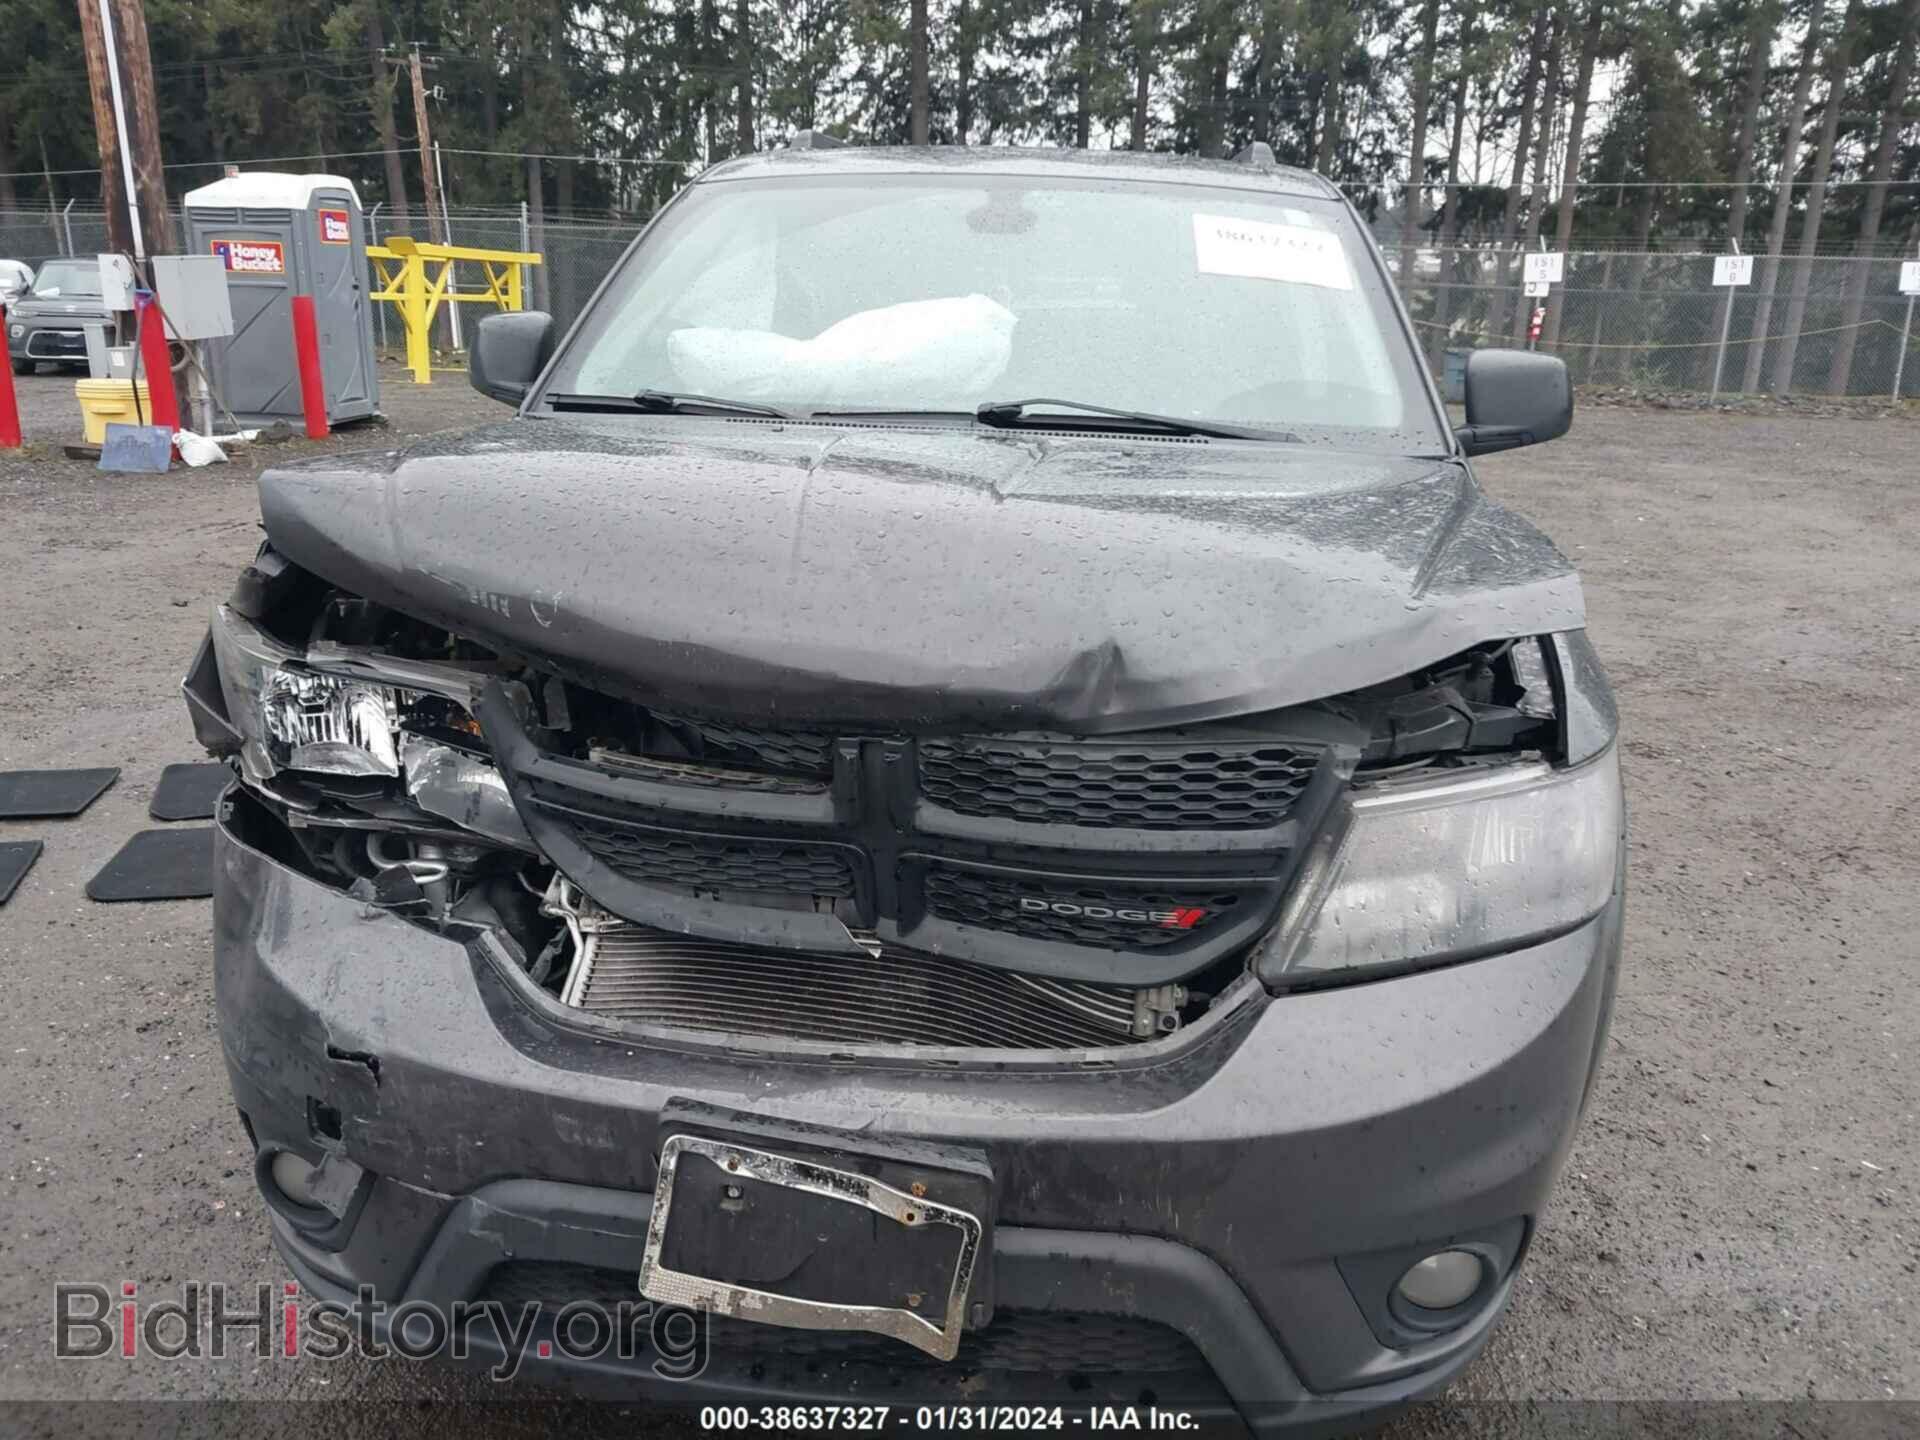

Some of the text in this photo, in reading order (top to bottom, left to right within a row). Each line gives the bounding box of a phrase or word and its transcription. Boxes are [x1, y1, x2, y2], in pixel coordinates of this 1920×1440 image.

[229, 242, 276, 261] Honey
[231, 256, 282, 272] Bucket
[1021, 898, 1178, 923] DODGE
